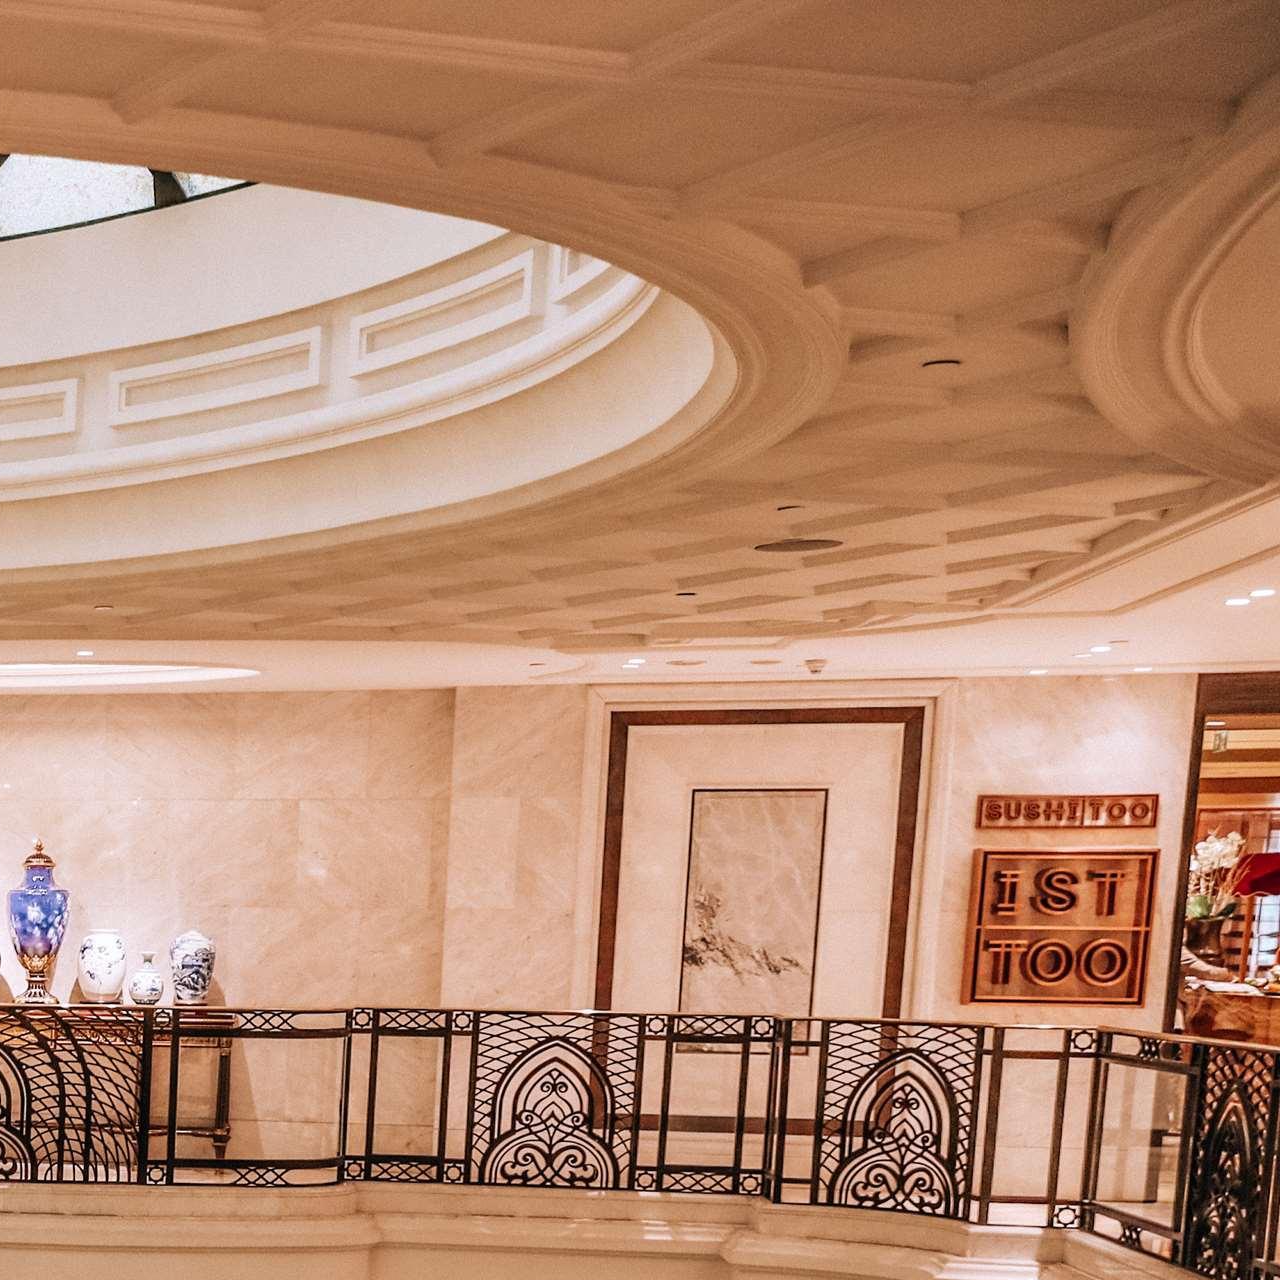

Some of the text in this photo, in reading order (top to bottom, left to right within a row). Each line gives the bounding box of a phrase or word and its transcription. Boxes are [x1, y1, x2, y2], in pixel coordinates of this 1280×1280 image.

[985, 799, 1150, 821] SUSHI TOO
[991, 866, 1132, 915] IST
[983, 937, 1131, 987] TOO
